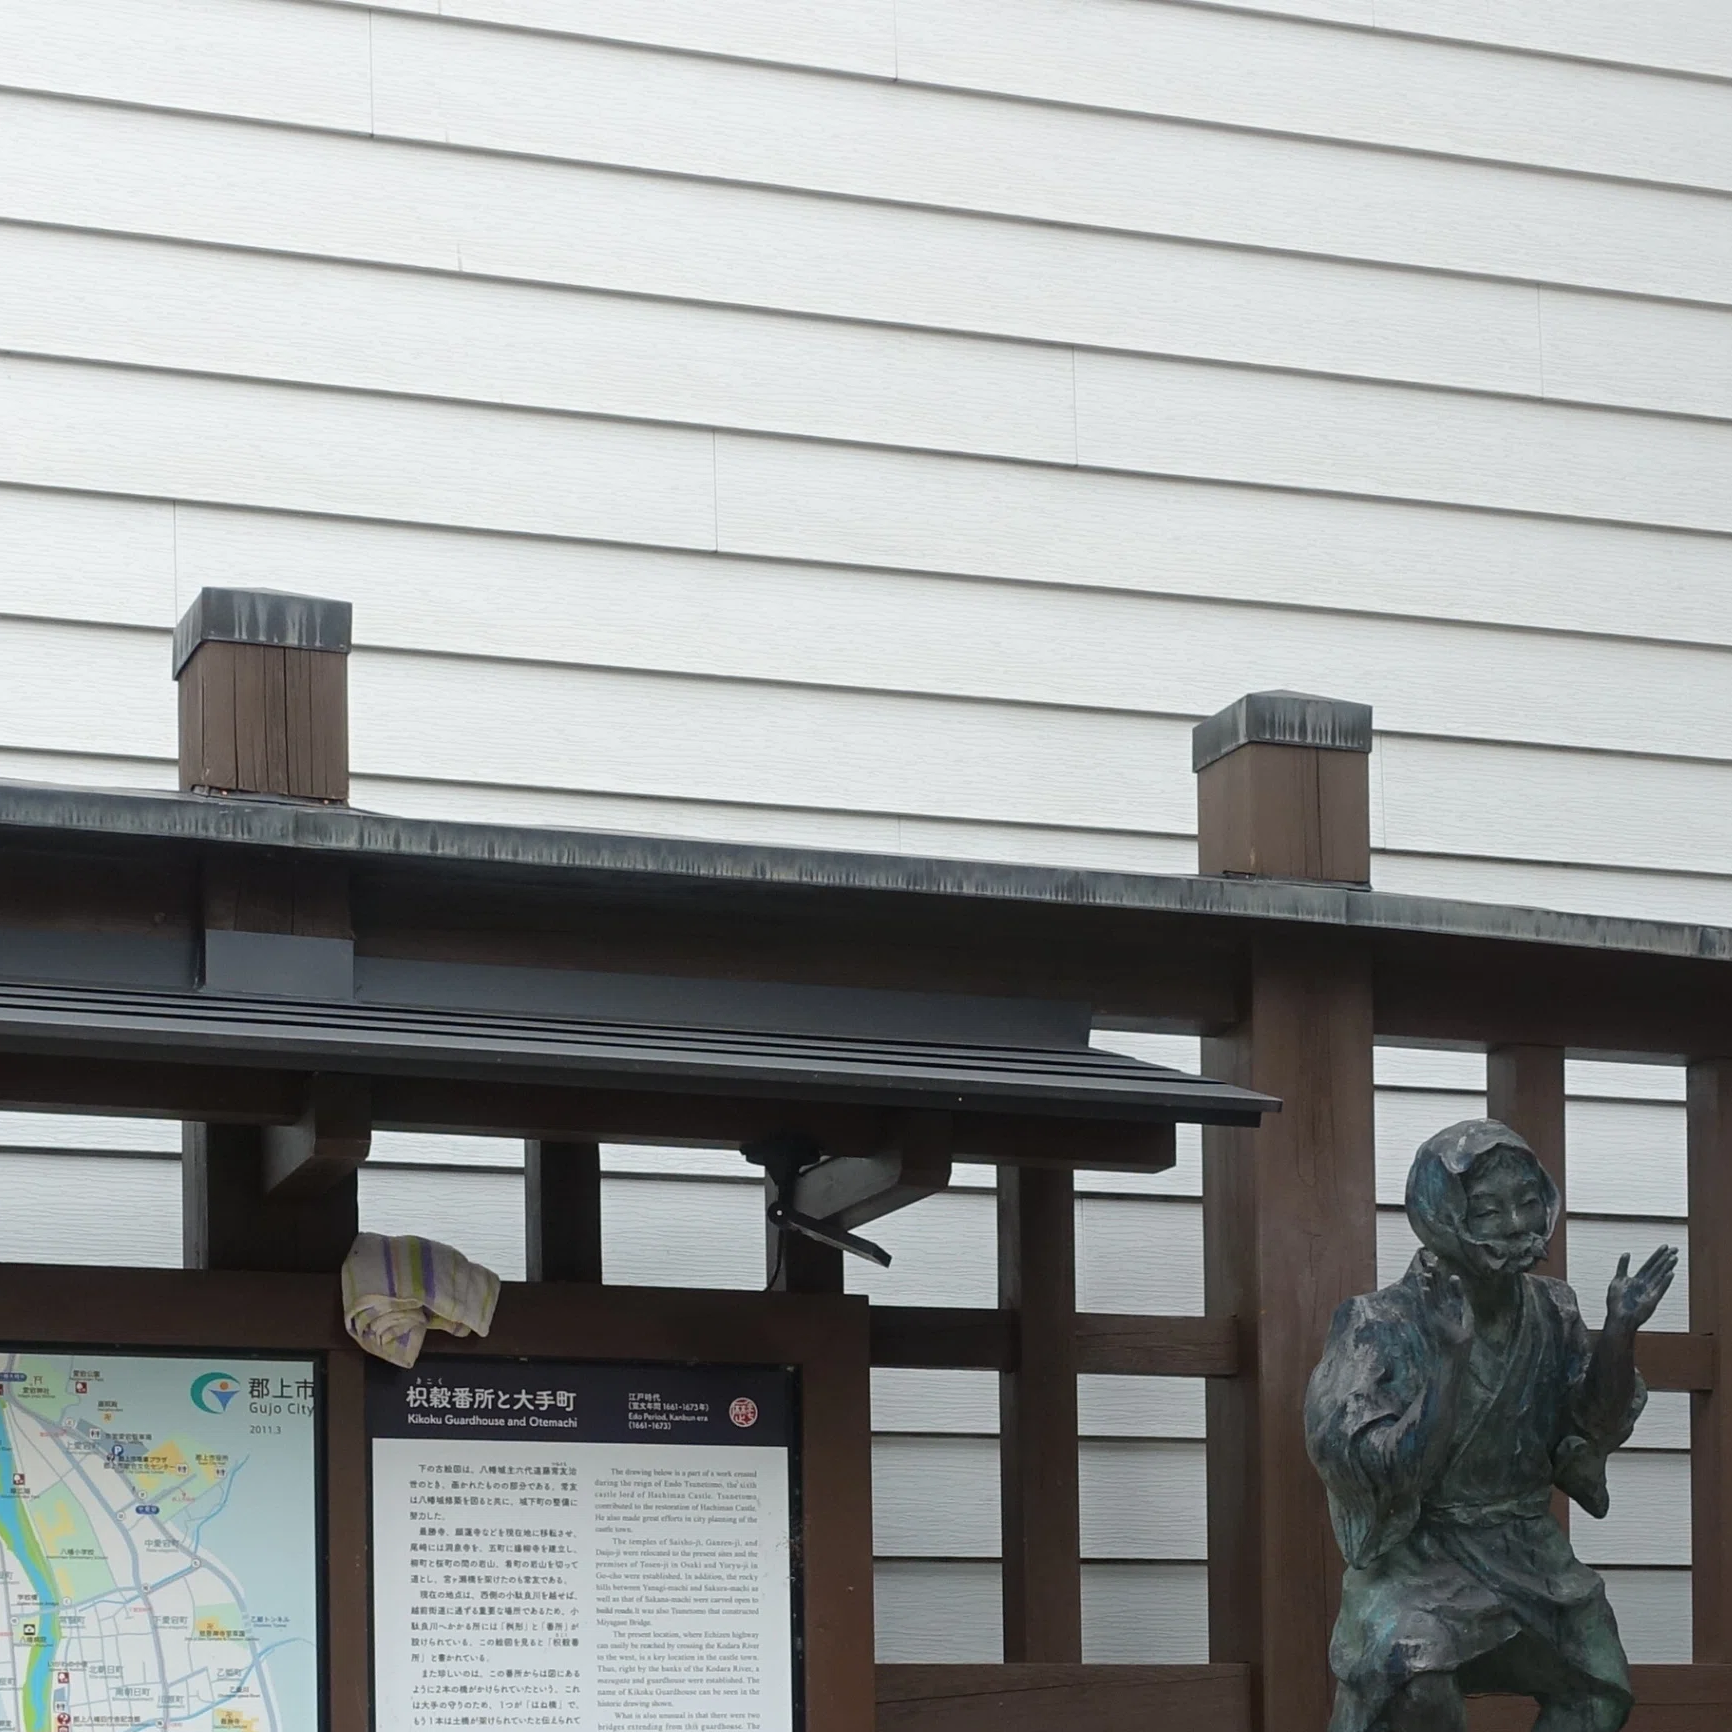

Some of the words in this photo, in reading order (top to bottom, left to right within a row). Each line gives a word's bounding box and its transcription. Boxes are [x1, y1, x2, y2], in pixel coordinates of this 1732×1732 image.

[248, 1377, 314, 1401] 郡上市
[406, 1385, 577, 1412] 枳穀番所と大手町
[628, 1393, 661, 1401] 江戸時代
[249, 1402, 282, 1416] Gujo
[287, 1402, 314, 1417] City
[407, 1413, 443, 1424] Kikoku
[444, 1414, 506, 1426] Guardhouse
[507, 1416, 526, 1426] and
[528, 1416, 578, 1428] Otemachi
[628, 1412, 642, 1421] Edo
[643, 1413, 668, 1422] Period,
[669, 1413, 696, 1422] Kanbun
[249, 1424, 282, 1435] 2011.3
[628, 1421, 672, 1430] (1661-1673)
[409, 1511, 445, 1521] 努力した。
